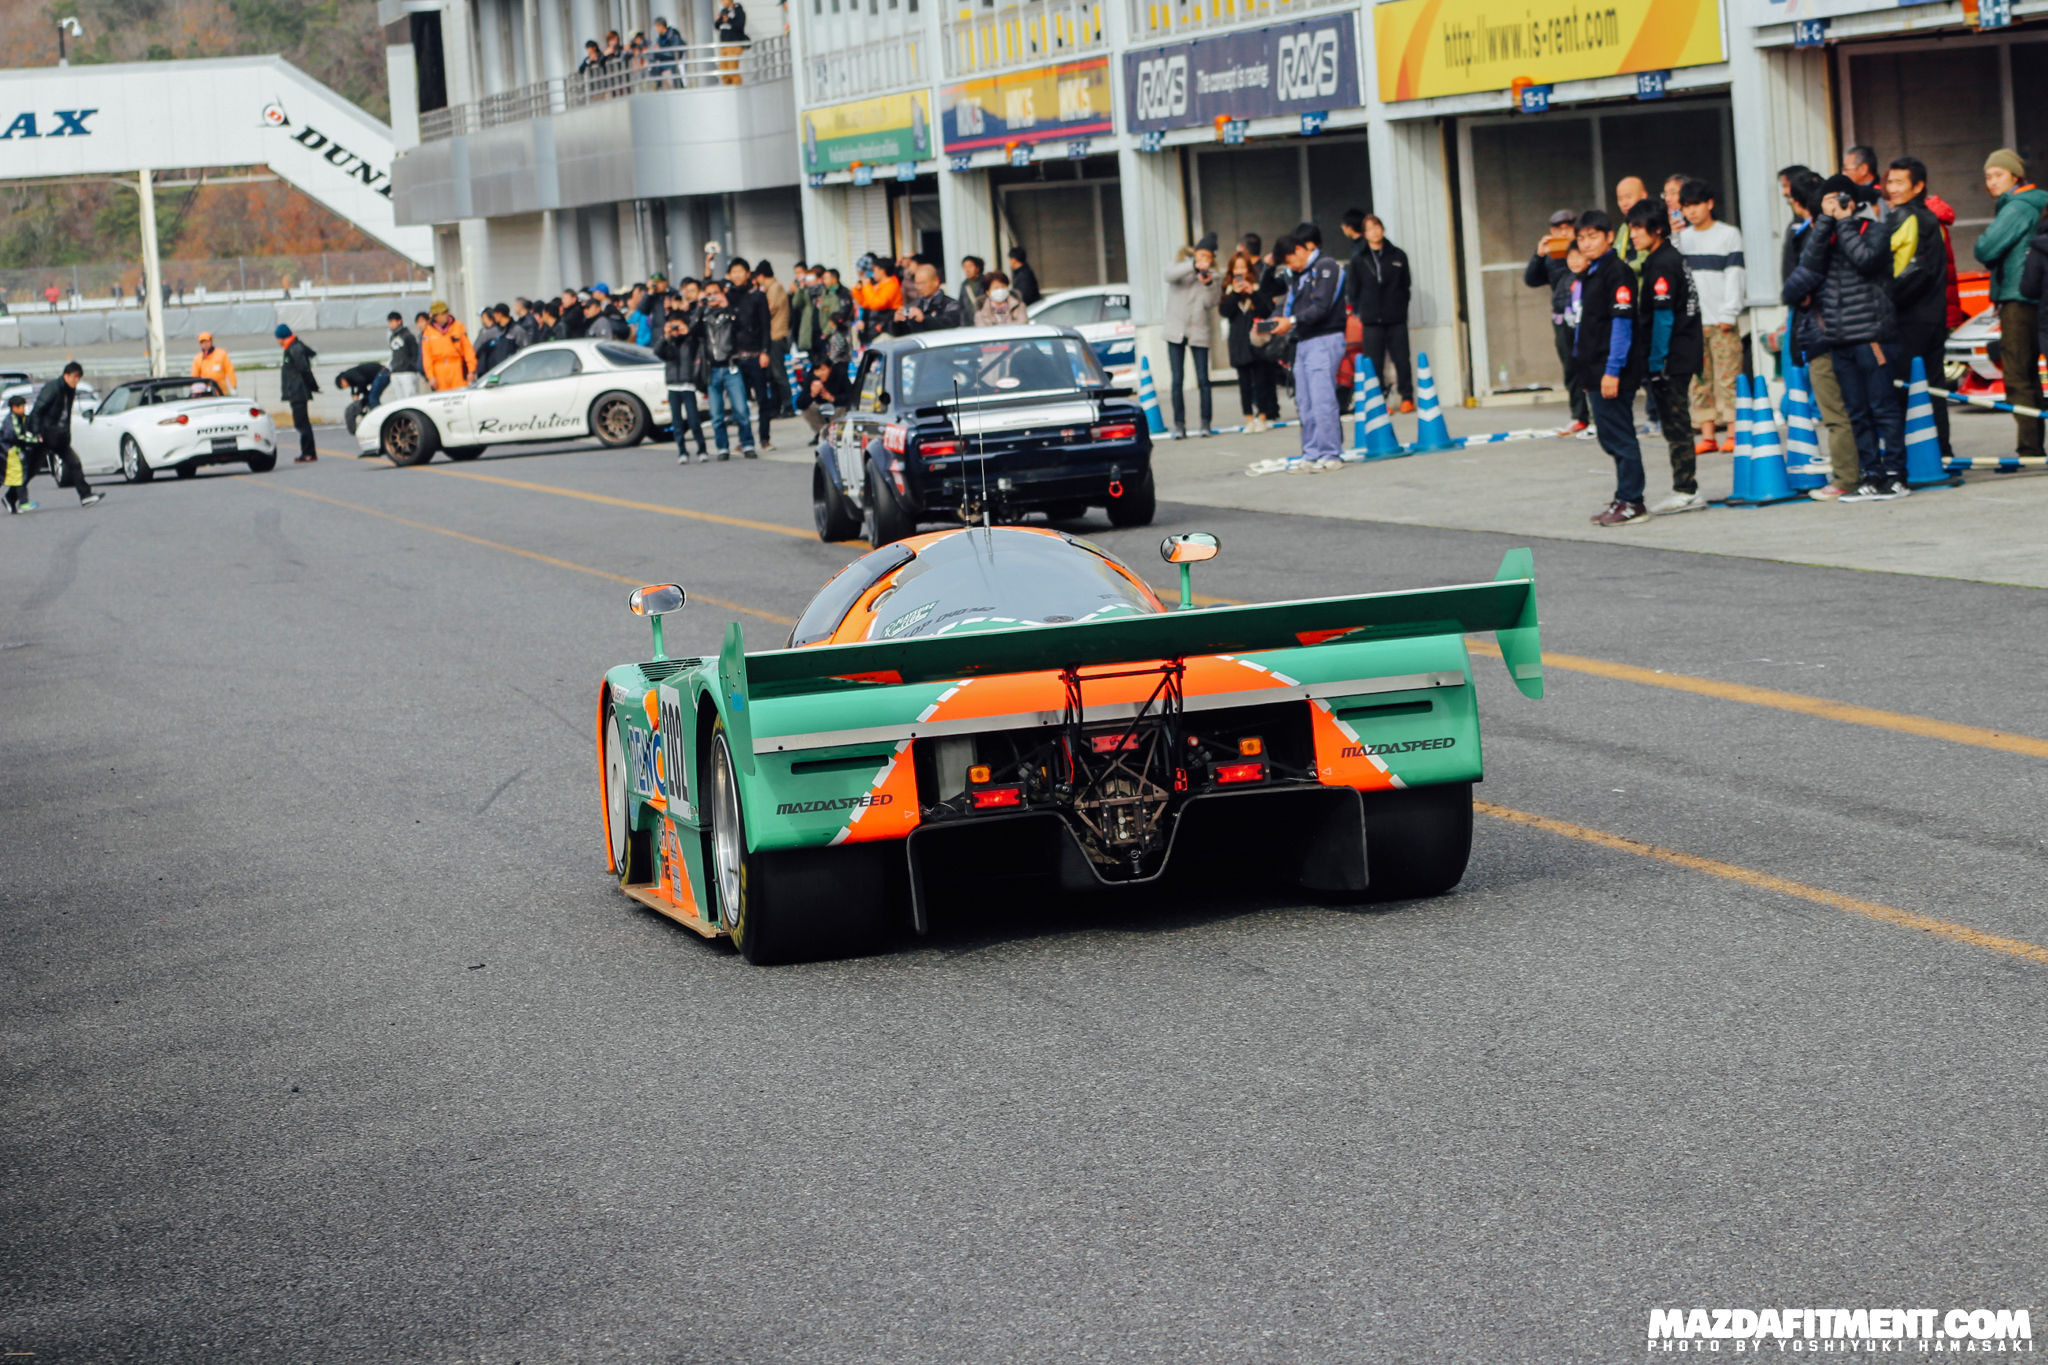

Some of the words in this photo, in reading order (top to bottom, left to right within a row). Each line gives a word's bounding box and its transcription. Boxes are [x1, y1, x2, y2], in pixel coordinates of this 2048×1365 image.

[1443, 7, 1619, 78] http://www.is-rent.com
[1277, 28, 1338, 101] RAYS
[1137, 54, 1188, 120] RAYS
[0, 109, 98, 139] AX
[196, 425, 249, 436] POTENZA
[477, 413, 581, 435] Revolution
[661, 700, 689, 802] 202
[1341, 737, 1456, 758] MAZDASPEED
[776, 794, 893, 815] MAZDASPEED
